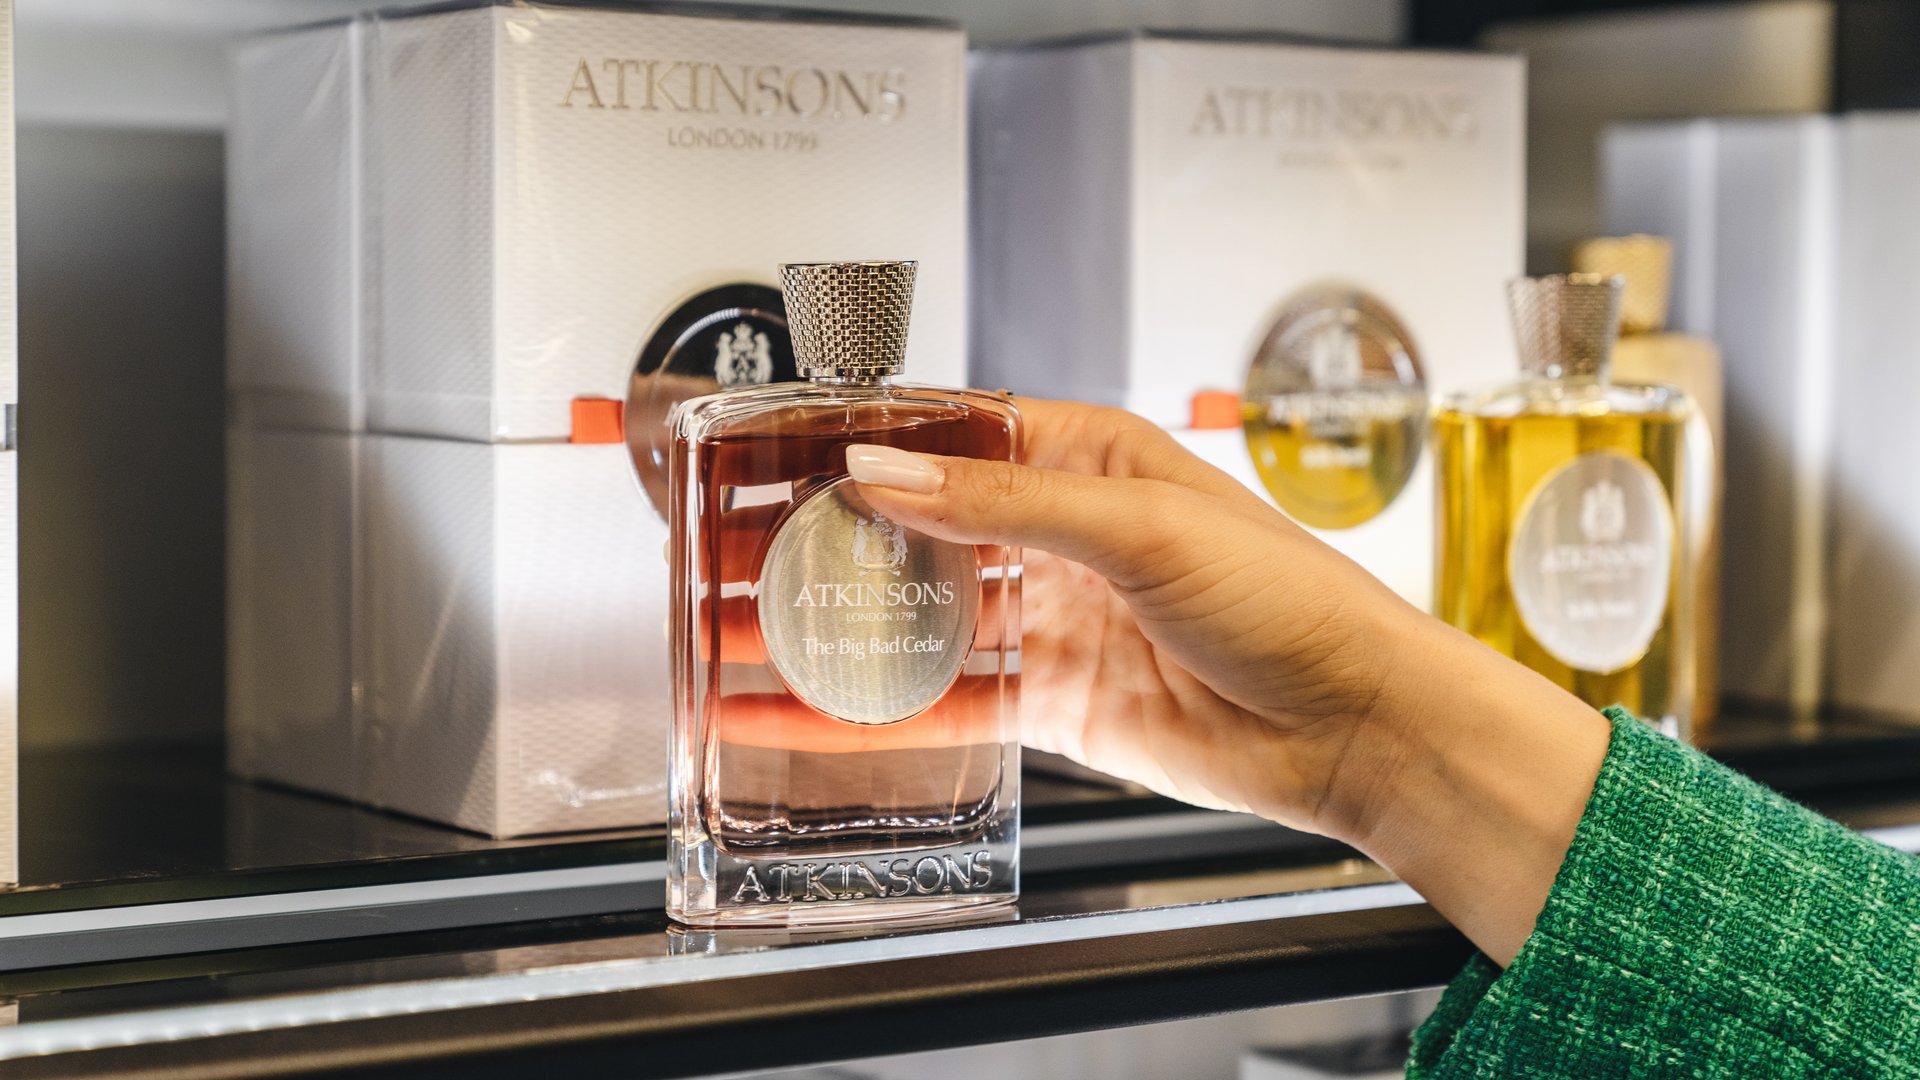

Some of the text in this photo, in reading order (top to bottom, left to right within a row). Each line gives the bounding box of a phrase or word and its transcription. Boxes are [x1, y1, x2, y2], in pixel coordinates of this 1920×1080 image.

[558, 56, 907, 123] ATKINSONS
[668, 126, 819, 151] LONDON 1799
[793, 581, 954, 607] ATKINSONS
[846, 611, 917, 623] LONDON 1799
[802, 634, 945, 660] The Big Bad Cedar
[733, 850, 993, 903] ATKINSONS
